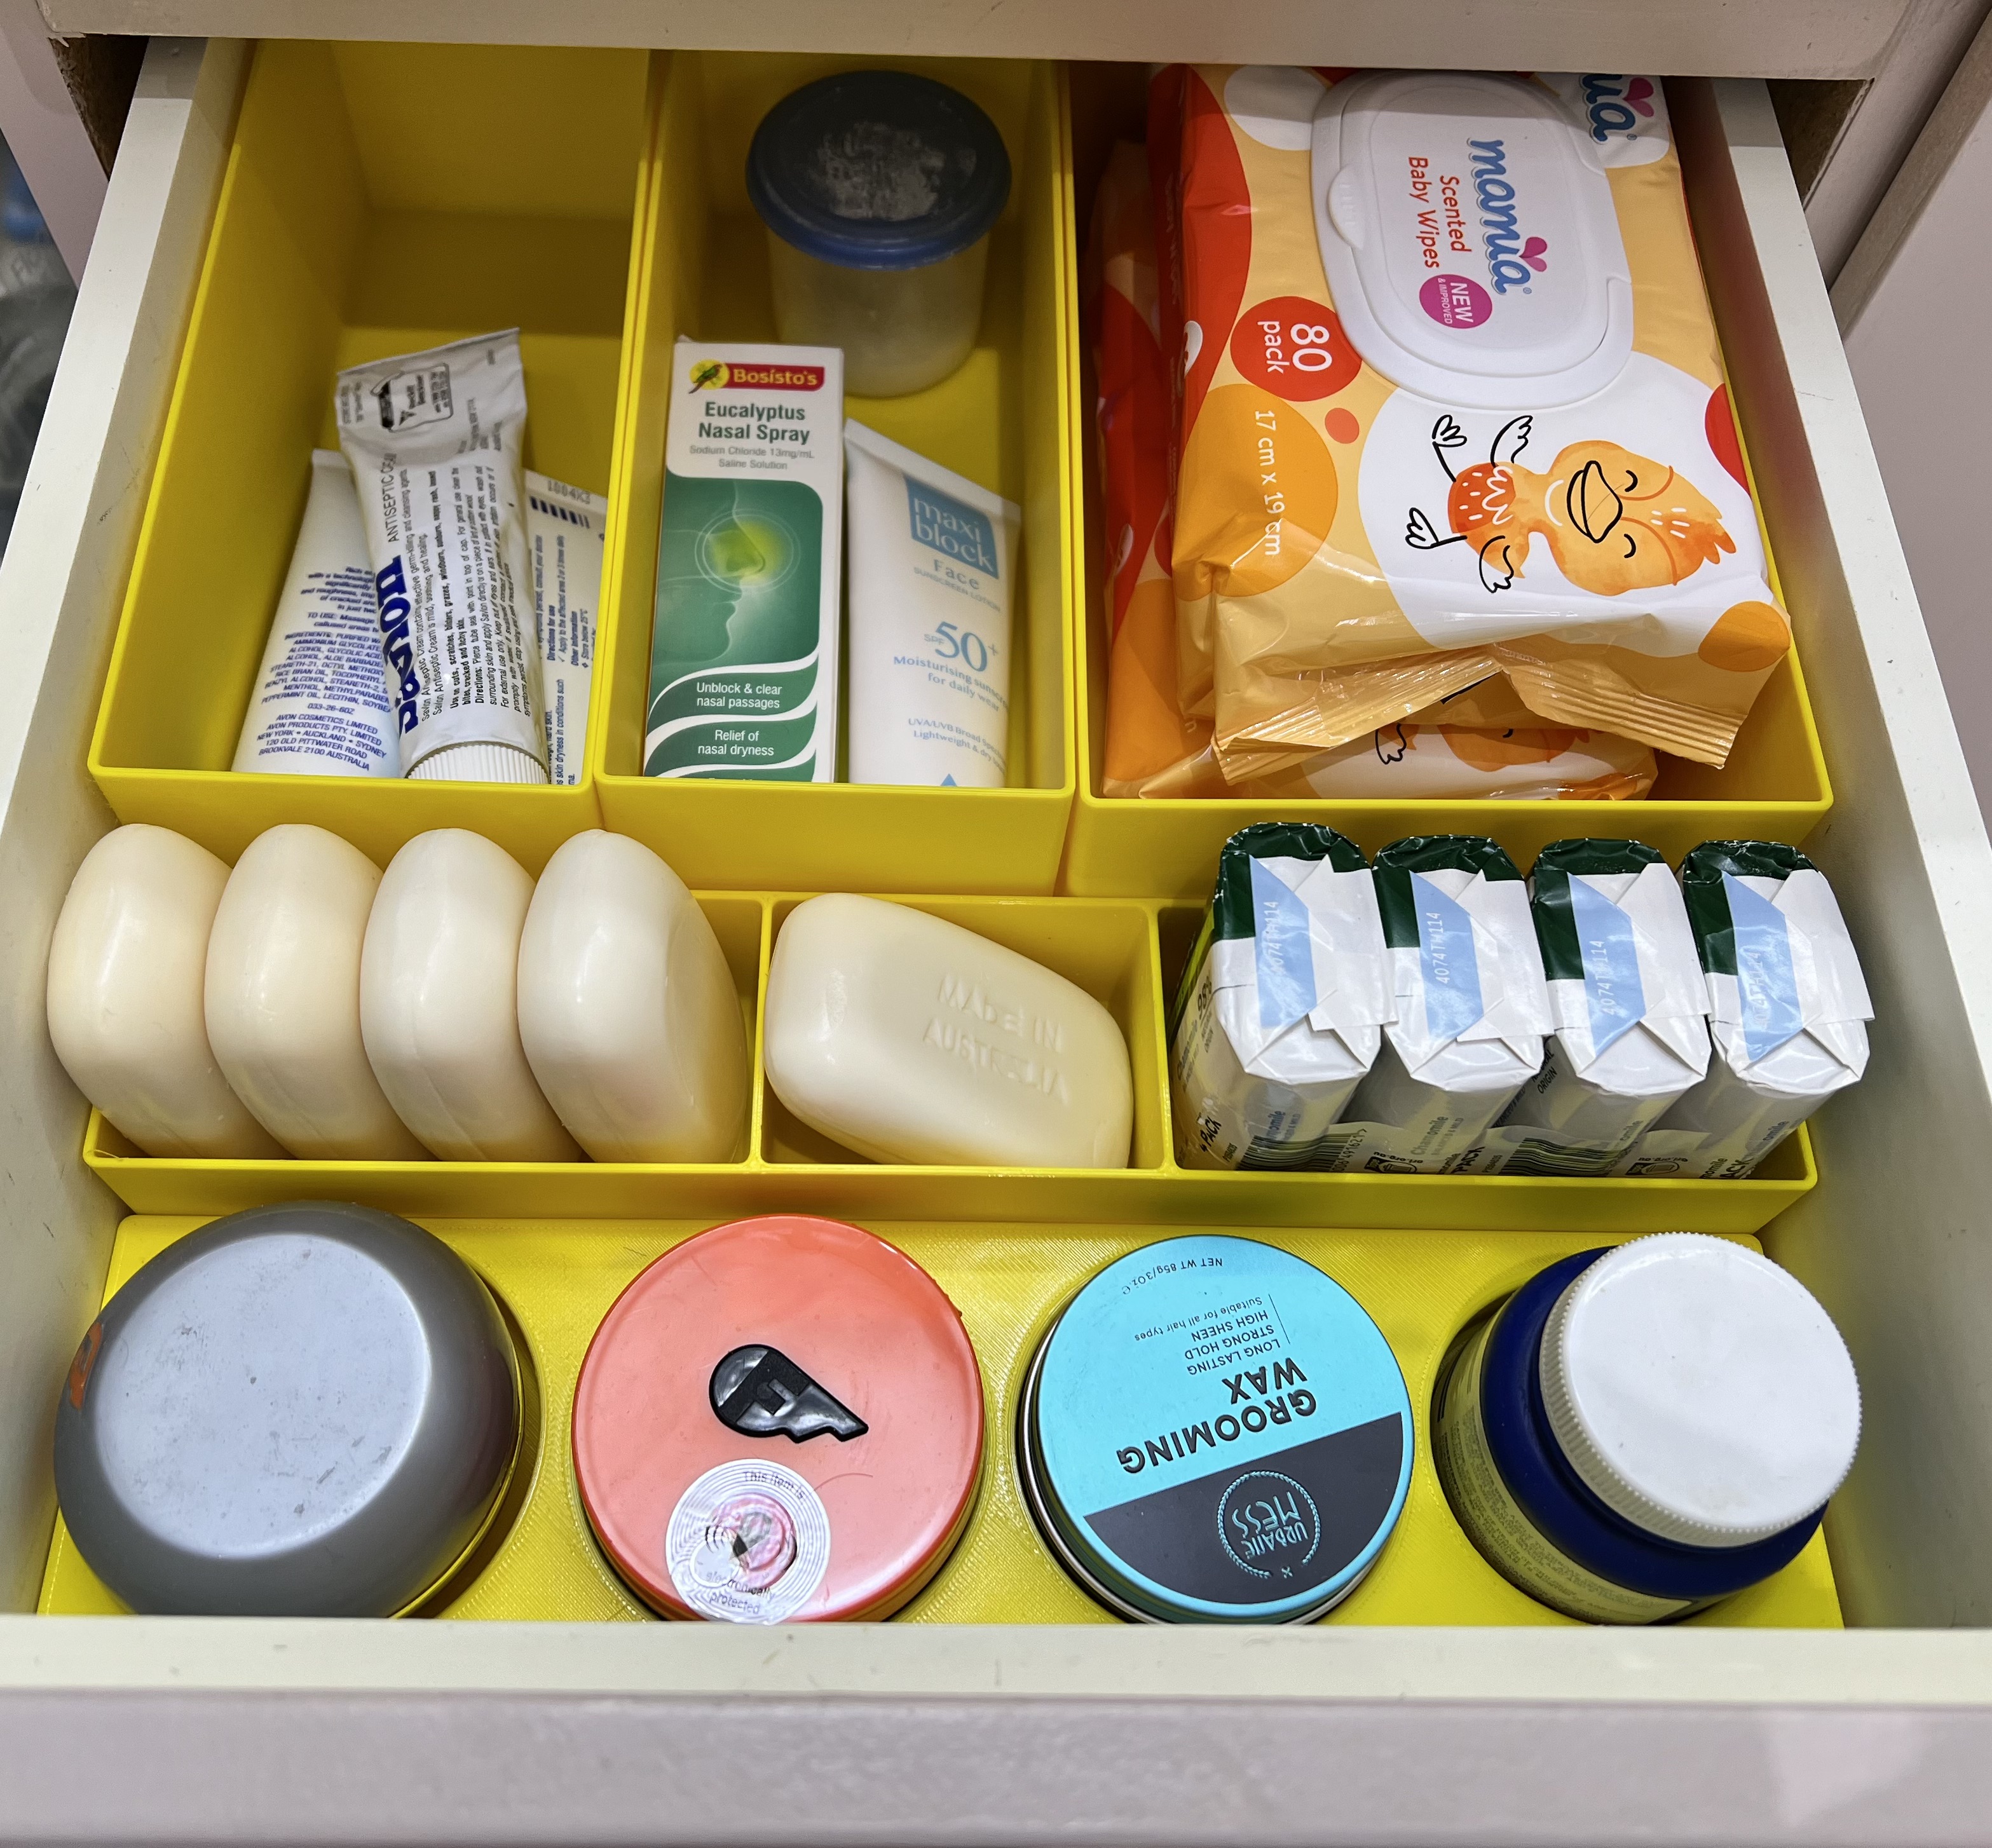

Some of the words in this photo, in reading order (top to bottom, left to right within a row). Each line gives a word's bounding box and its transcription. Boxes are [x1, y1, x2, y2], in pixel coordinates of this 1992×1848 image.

[1409, 156, 1431, 203] Baby
[1440, 175, 1471, 252] Scented
[1468, 139, 1548, 296] mamia
[1416, 210, 1440, 268] Wipes
[1438, 284, 1453, 324] IMPROVED
[1449, 282, 1473, 323] NEW
[1257, 321, 1290, 374] pack
[1290, 323, 1333, 372] 80
[733, 369, 817, 385] Bosisto's
[705, 401, 805, 422] Eucalyptus
[1255, 411, 1276, 431] 17
[699, 423, 750, 439] Nasal
[757, 425, 810, 445] Spray
[690, 445, 725, 454] Sodium
[728, 446, 766, 456] Chloride
[770, 448, 814, 459] 13mg/mL
[1258, 437, 1275, 466] cm
[719, 459, 747, 468] Saline
[750, 459, 788, 470] Solution
[1261, 472, 1277, 486] x
[381, 474, 399, 543] ANTISEPTIC
[1264, 492, 1285, 513] 19
[913, 498, 981, 543] maxi
[916, 514, 994, 572] block
[1265, 521, 1281, 555] cm
[933, 559, 979, 590] Face
[411, 576, 422, 605] effective
[442, 583, 453, 607] grazes,
[339, 615, 374, 623] Massage
[425, 604, 435, 621] mild,
[480, 602, 490, 622] Savlon
[427, 630, 438, 653] Cream
[470, 629, 478, 642] tube
[482, 623, 494, 639] apply
[924, 634, 945, 646] SPF
[327, 648, 363, 656] GLYCOLIC
[416, 634, 425, 656] Cream
[446, 632, 457, 665] scratches,
[458, 647, 467, 658] and
[472, 646, 481, 664] Pierce
[484, 640, 493, 651] and
[547, 628, 556, 661] Directions
[484, 653, 494, 666] skin
[894, 656, 972, 684] Moisturising
[428, 654, 444, 691] Antiseptic
[452, 668, 460, 686] cuts,
[459, 661, 470, 687] cracked
[499, 668, 508, 694] external
[474, 667, 484, 703] Directions:
[486, 667, 497, 705] surrounding
[509, 680, 521, 712] promptly
[556, 679, 564, 694] such
[697, 683, 740, 693] Unblock
[744, 684, 752, 693] &
[756, 684, 782, 695] clear
[928, 672, 945, 684] for
[949, 680, 975, 698] daily
[978, 694, 1000, 712] wear
[324, 693, 360, 705] LECITHIN,
[421, 698, 431, 721] Savlon
[433, 694, 444, 715] Savlon
[500, 697, 509, 707] For
[521, 684, 531, 717] symptoms
[697, 697, 725, 707] nasal
[728, 698, 780, 710] passages
[556, 696, 564, 728] conditions
[267, 722, 286, 730] AVON
[288, 721, 330, 731] PRODUCTS
[332, 726, 348, 734] PTY.
[350, 730, 382, 746] LIMITED
[298, 714, 345, 724] COSMETICS
[346, 719, 378, 735] LIMITED
[714, 730, 745, 740] Relief
[748, 731, 759, 740] of
[908, 718, 953, 731] UVA/UVB
[955, 726, 980, 742] Broad
[257, 731, 273, 741] NEW
[303, 730, 346, 742] AUCKLAND
[356, 740, 387, 759] SYDNEY
[298, 738, 343, 752] PITTWATER
[345, 746, 367, 759] ROAD
[555, 737, 565, 763] dryness
[698, 744, 727, 754] nasal
[730, 745, 774, 757] dryness
[913, 730, 971, 749] Lightweight
[259, 746, 302, 756] BROOKVALE
[306, 747, 325, 755] 2100
[326, 750, 369, 771] AUSTRALIA
[555, 764, 564, 778] skin
[1426, 912, 1450, 984] 4074TH114
[1537, 1068, 1558, 1095] ORIGIN
[1201, 1115, 1222, 1148] PACK
[1410, 1115, 1449, 1156] Chamomile
[1180, 1259, 1197, 1269] WT
[1201, 1258, 1222, 1267] NET
[1203, 1304, 1218, 1321] for
[1220, 1296, 1263, 1317] Suitable
[1166, 1320, 1185, 1333] hair
[1187, 1315, 1200, 1327] all
[1235, 1309, 1268, 1329] HIGH
[1134, 1325, 1163, 1342] types
[1190, 1321, 1232, 1342] SHEEN
[1222, 1324, 1274, 1349] STRONG
[1184, 1340, 1219, 1361] HOLD
[1243, 1338, 1281, 1358] LONG
[1186, 1351, 1241, 1376] LASTING
[1221, 1357, 1307, 1405] WAX
[1115, 1389, 1316, 1474] GROOMING
[1231, 1491, 1301, 1539] MESS
[709, 1592, 761, 1615] protected
